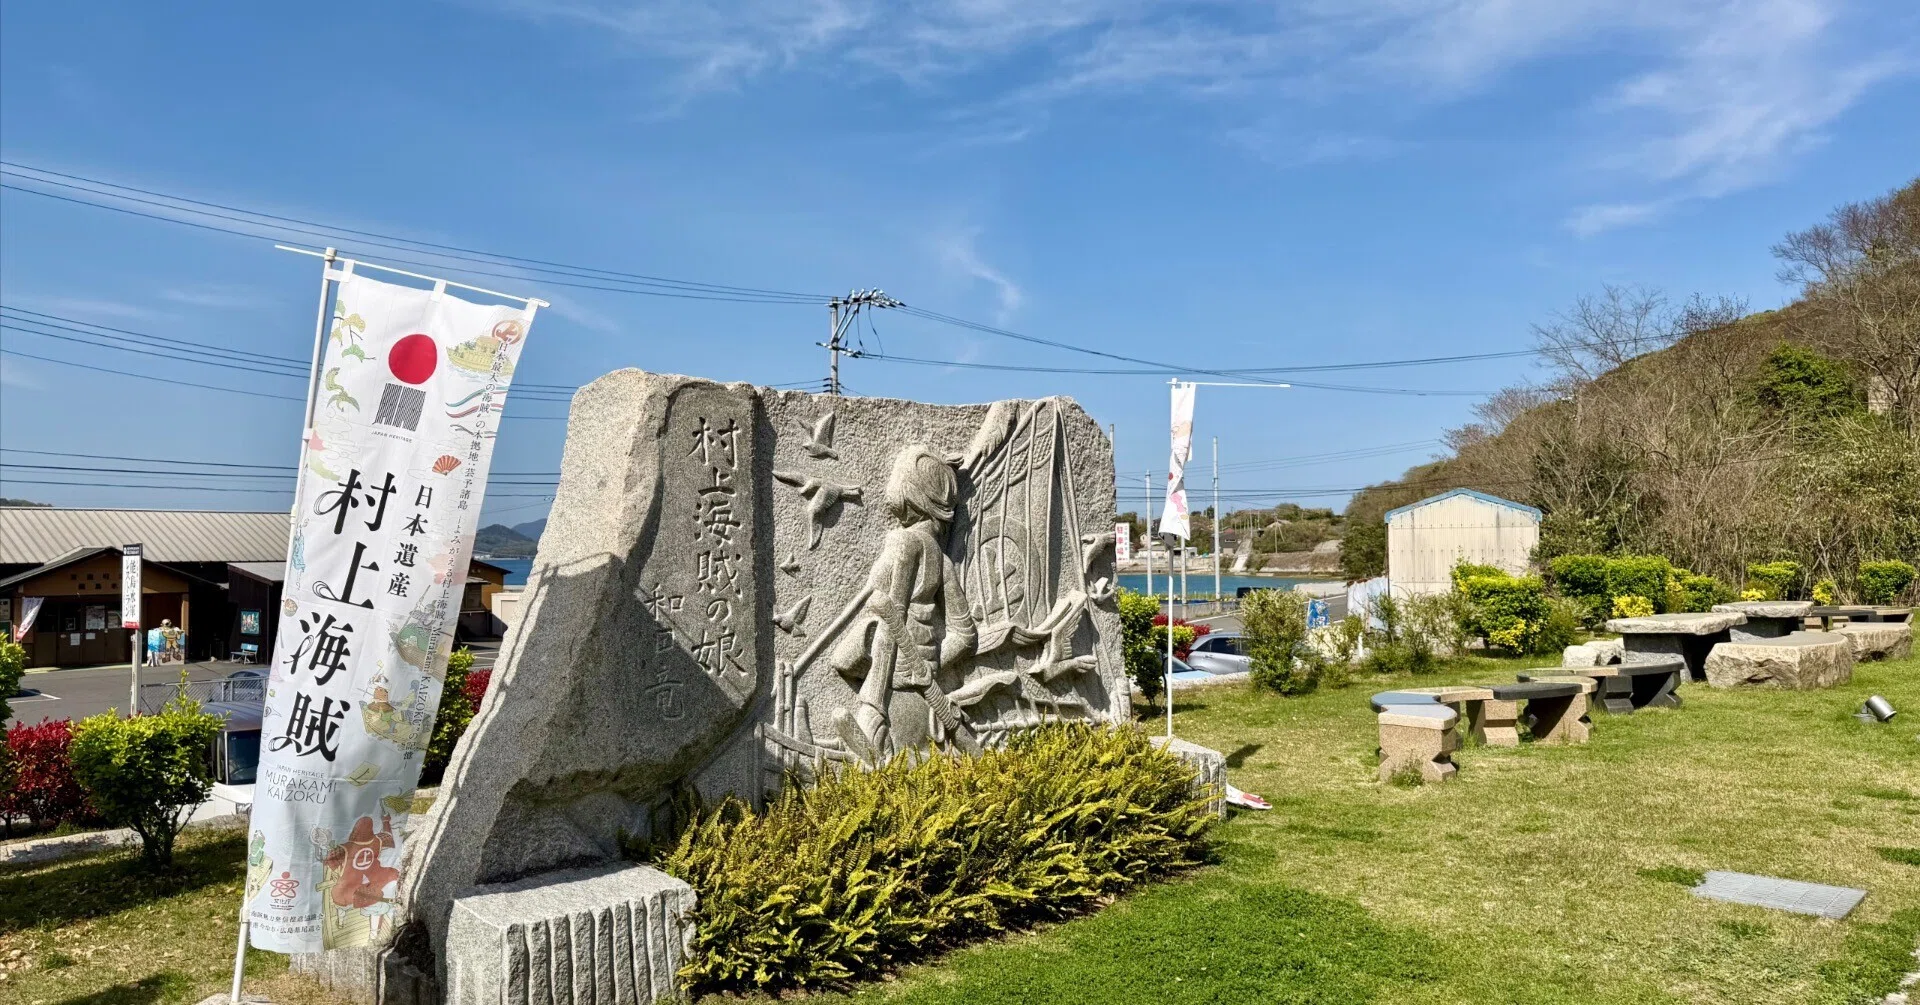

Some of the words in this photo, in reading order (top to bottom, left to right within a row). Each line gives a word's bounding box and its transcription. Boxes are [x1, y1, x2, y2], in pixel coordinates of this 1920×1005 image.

[387, 484, 433, 598] 日本遺産
[686, 416, 748, 678] 村上海賊の娘
[268, 468, 397, 763] 村上海賊
[643, 583, 685, 722] 和田竜
[265, 769, 337, 794] MURAKAMI
[267, 784, 327, 805] KAIZOKU
[277, 764, 292, 774] JAPAN
[292, 769, 325, 780] HERITAGE
